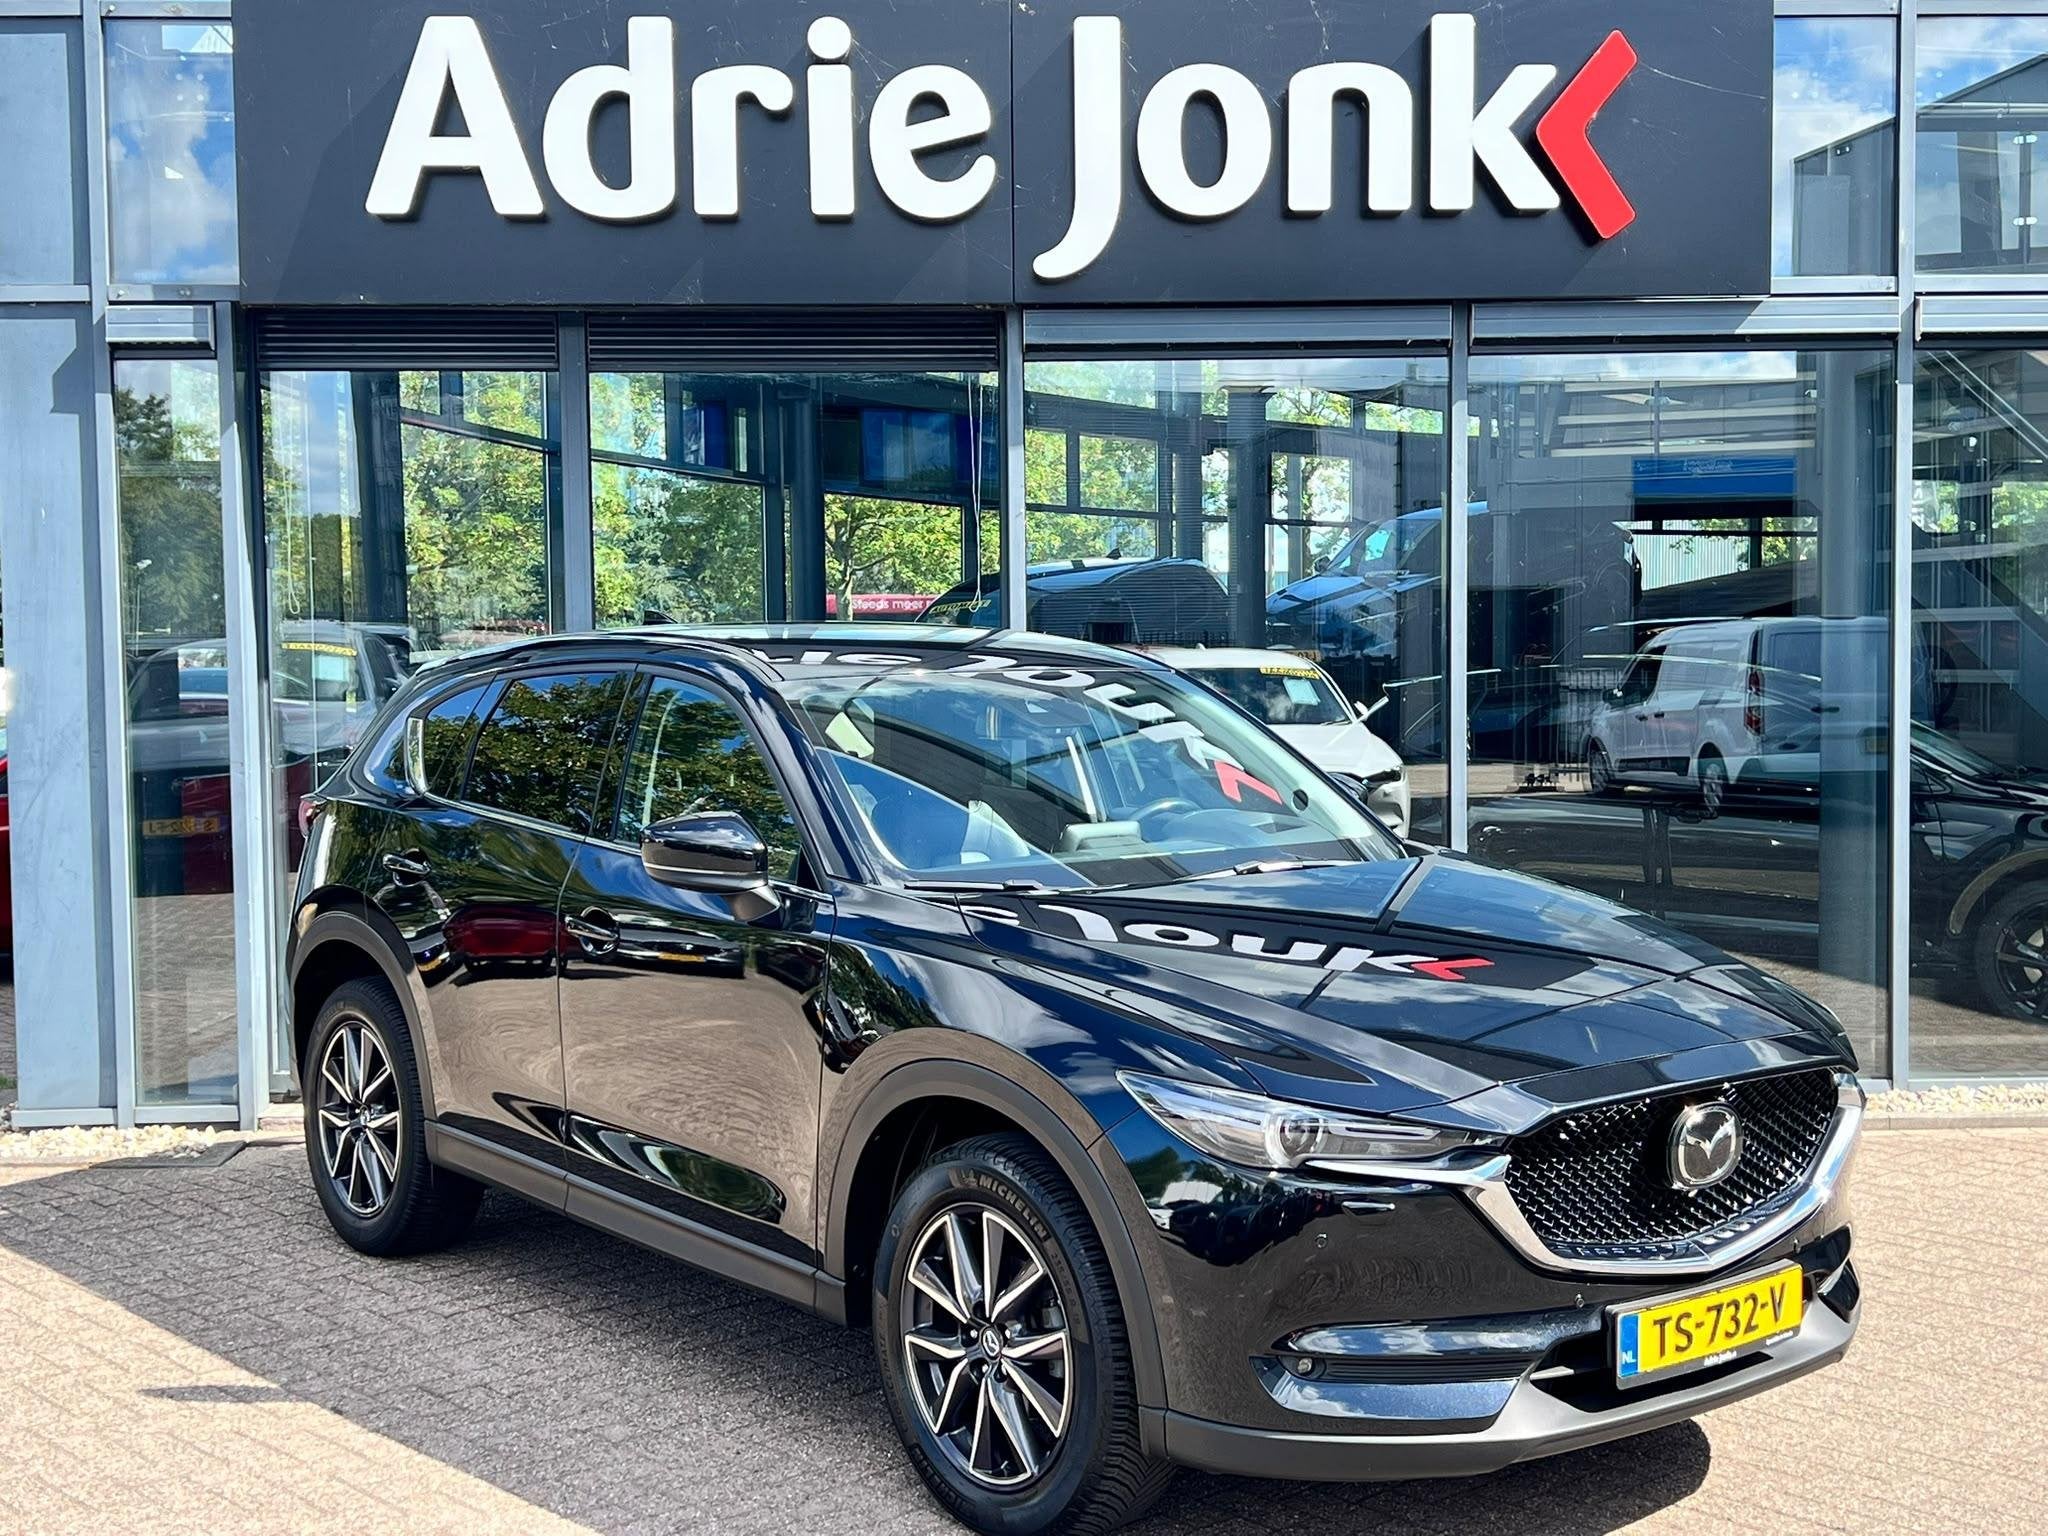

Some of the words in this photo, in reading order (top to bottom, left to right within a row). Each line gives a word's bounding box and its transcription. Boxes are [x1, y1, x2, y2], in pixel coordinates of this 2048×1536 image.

[365, 15, 997, 221] Adrie
[1032, 13, 1560, 280] Jonk
[978, 1175, 1049, 1242] MICHELIN
[1652, 1282, 1786, 1359] TS-732-V
[1621, 1352, 1636, 1366] NL
